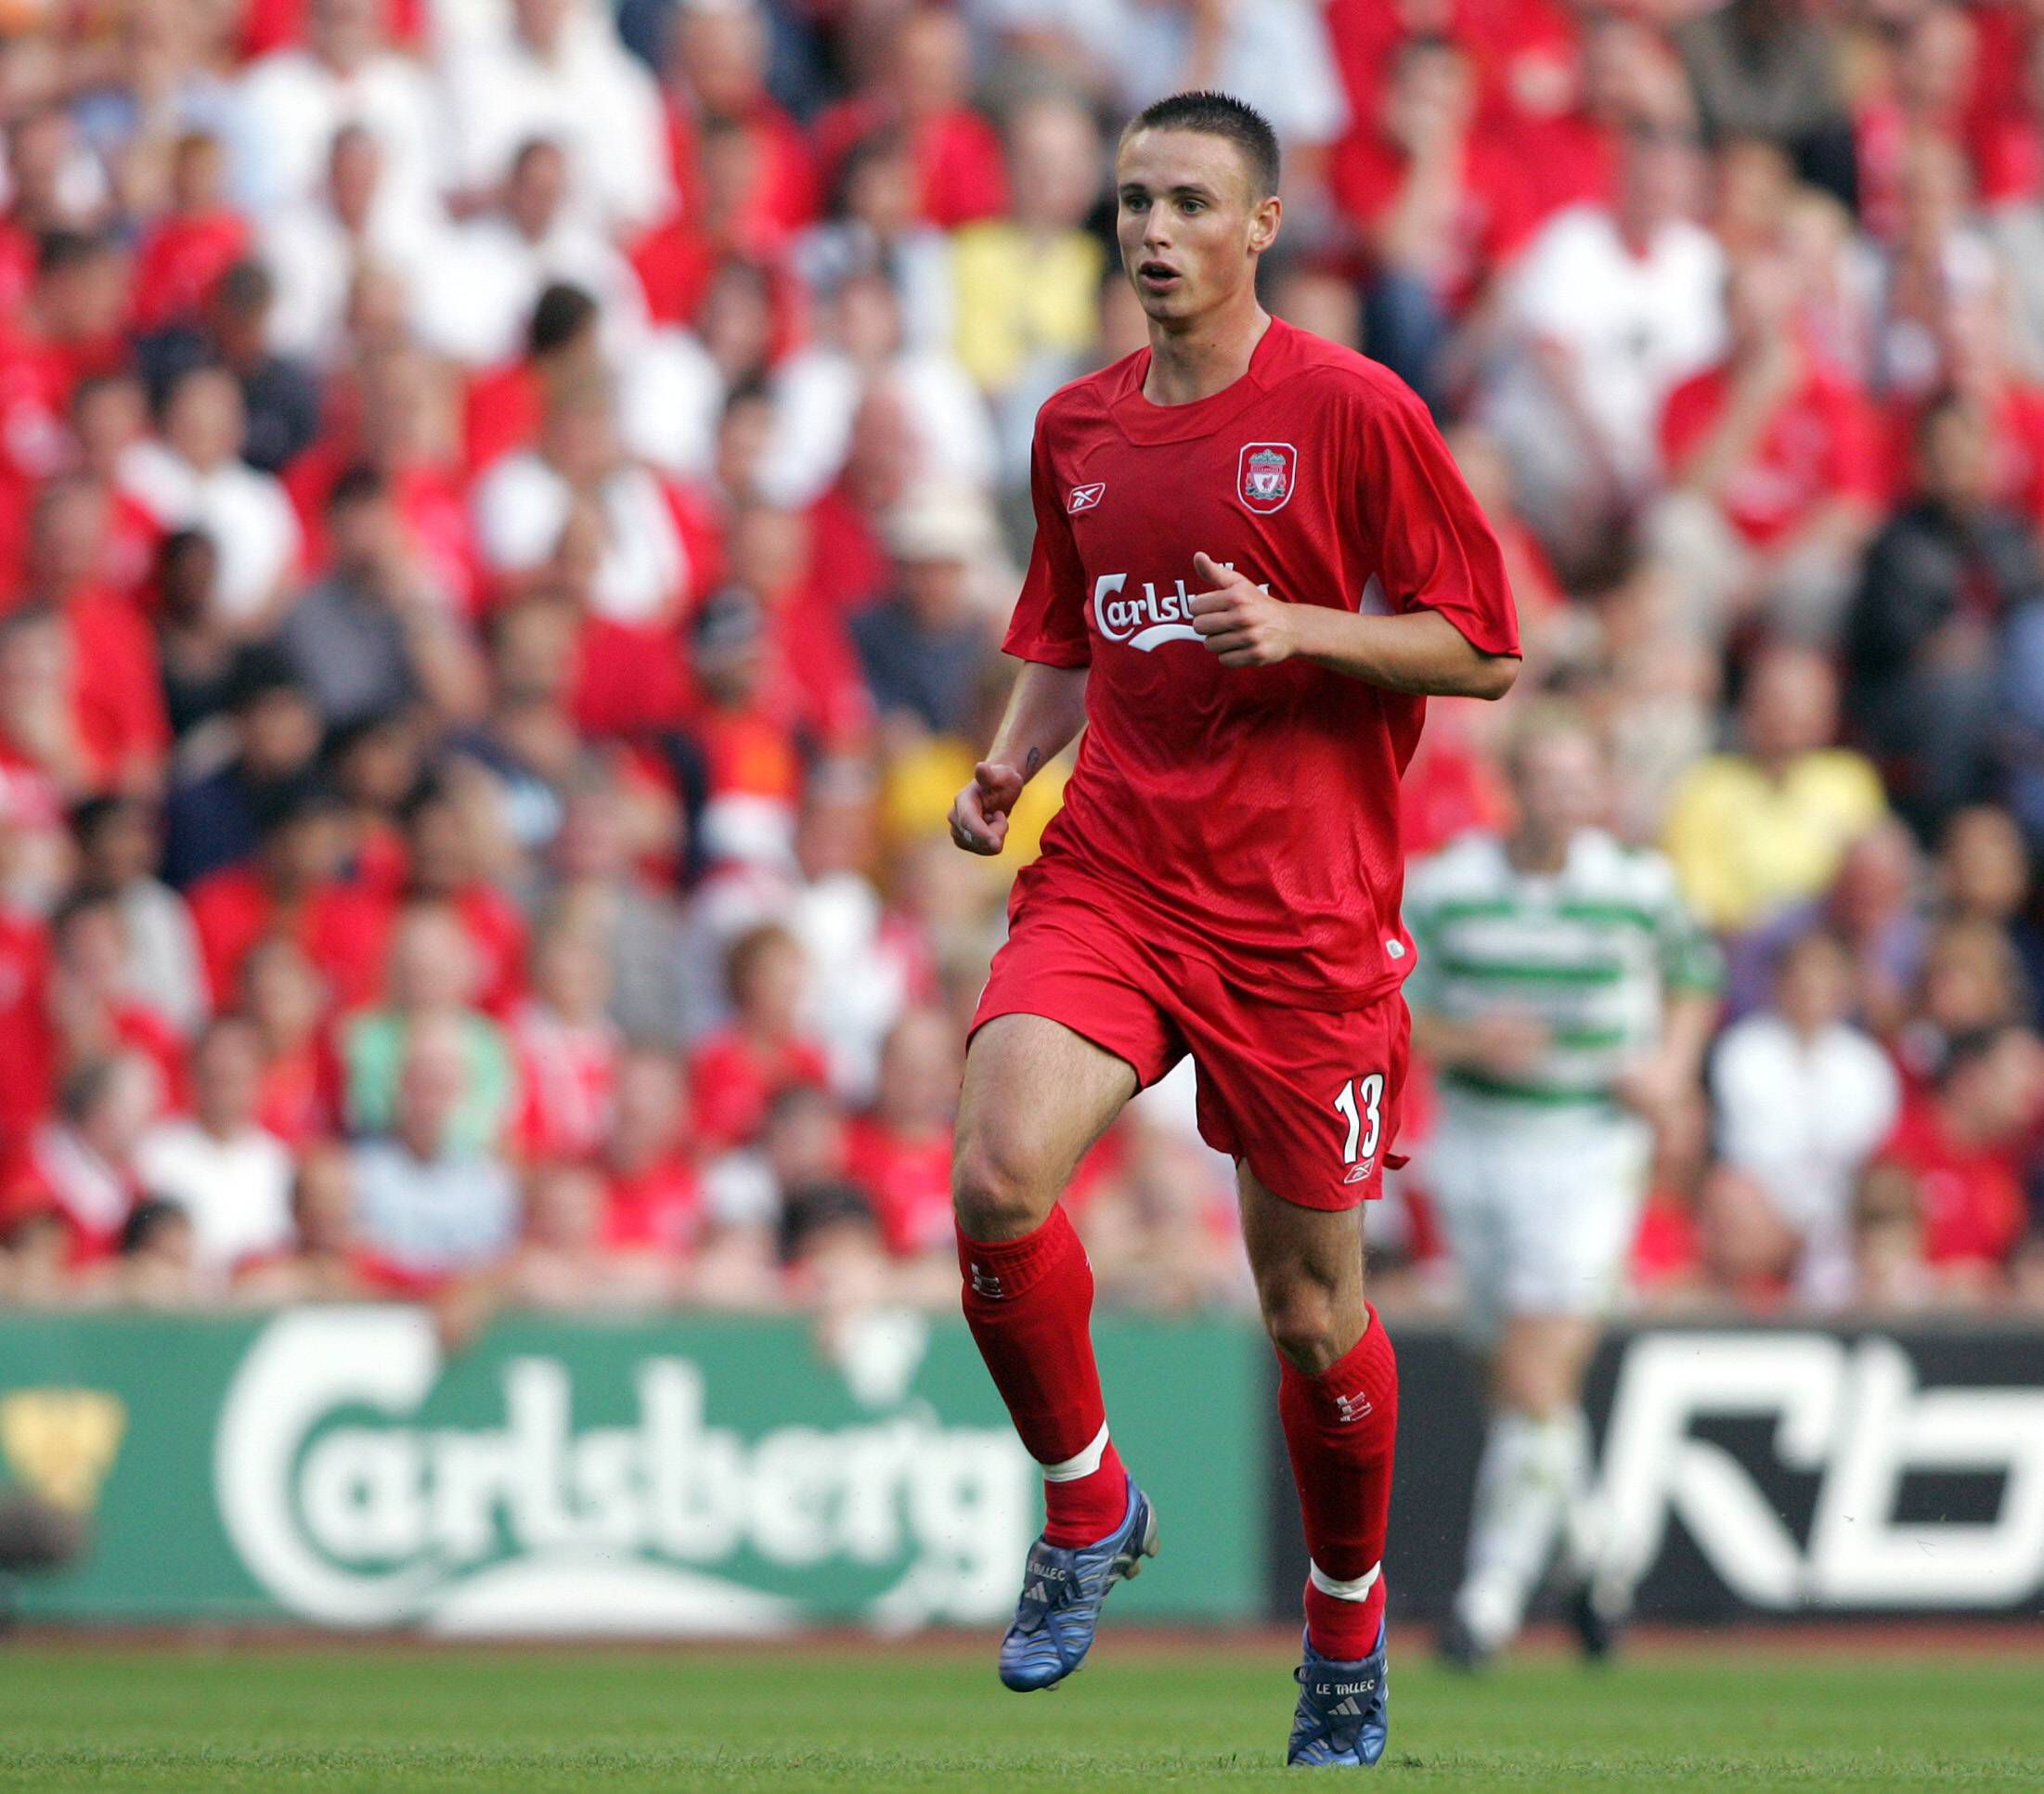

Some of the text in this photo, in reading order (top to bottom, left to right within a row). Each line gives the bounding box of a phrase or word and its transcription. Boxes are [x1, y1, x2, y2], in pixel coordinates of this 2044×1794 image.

[1094, 572, 1269, 641] Carlsb
[1334, 1073, 1385, 1165] 13
[213, 1302, 1040, 1631] Carlsberg
[1315, 1679, 1375, 1696] LE TALLEC
